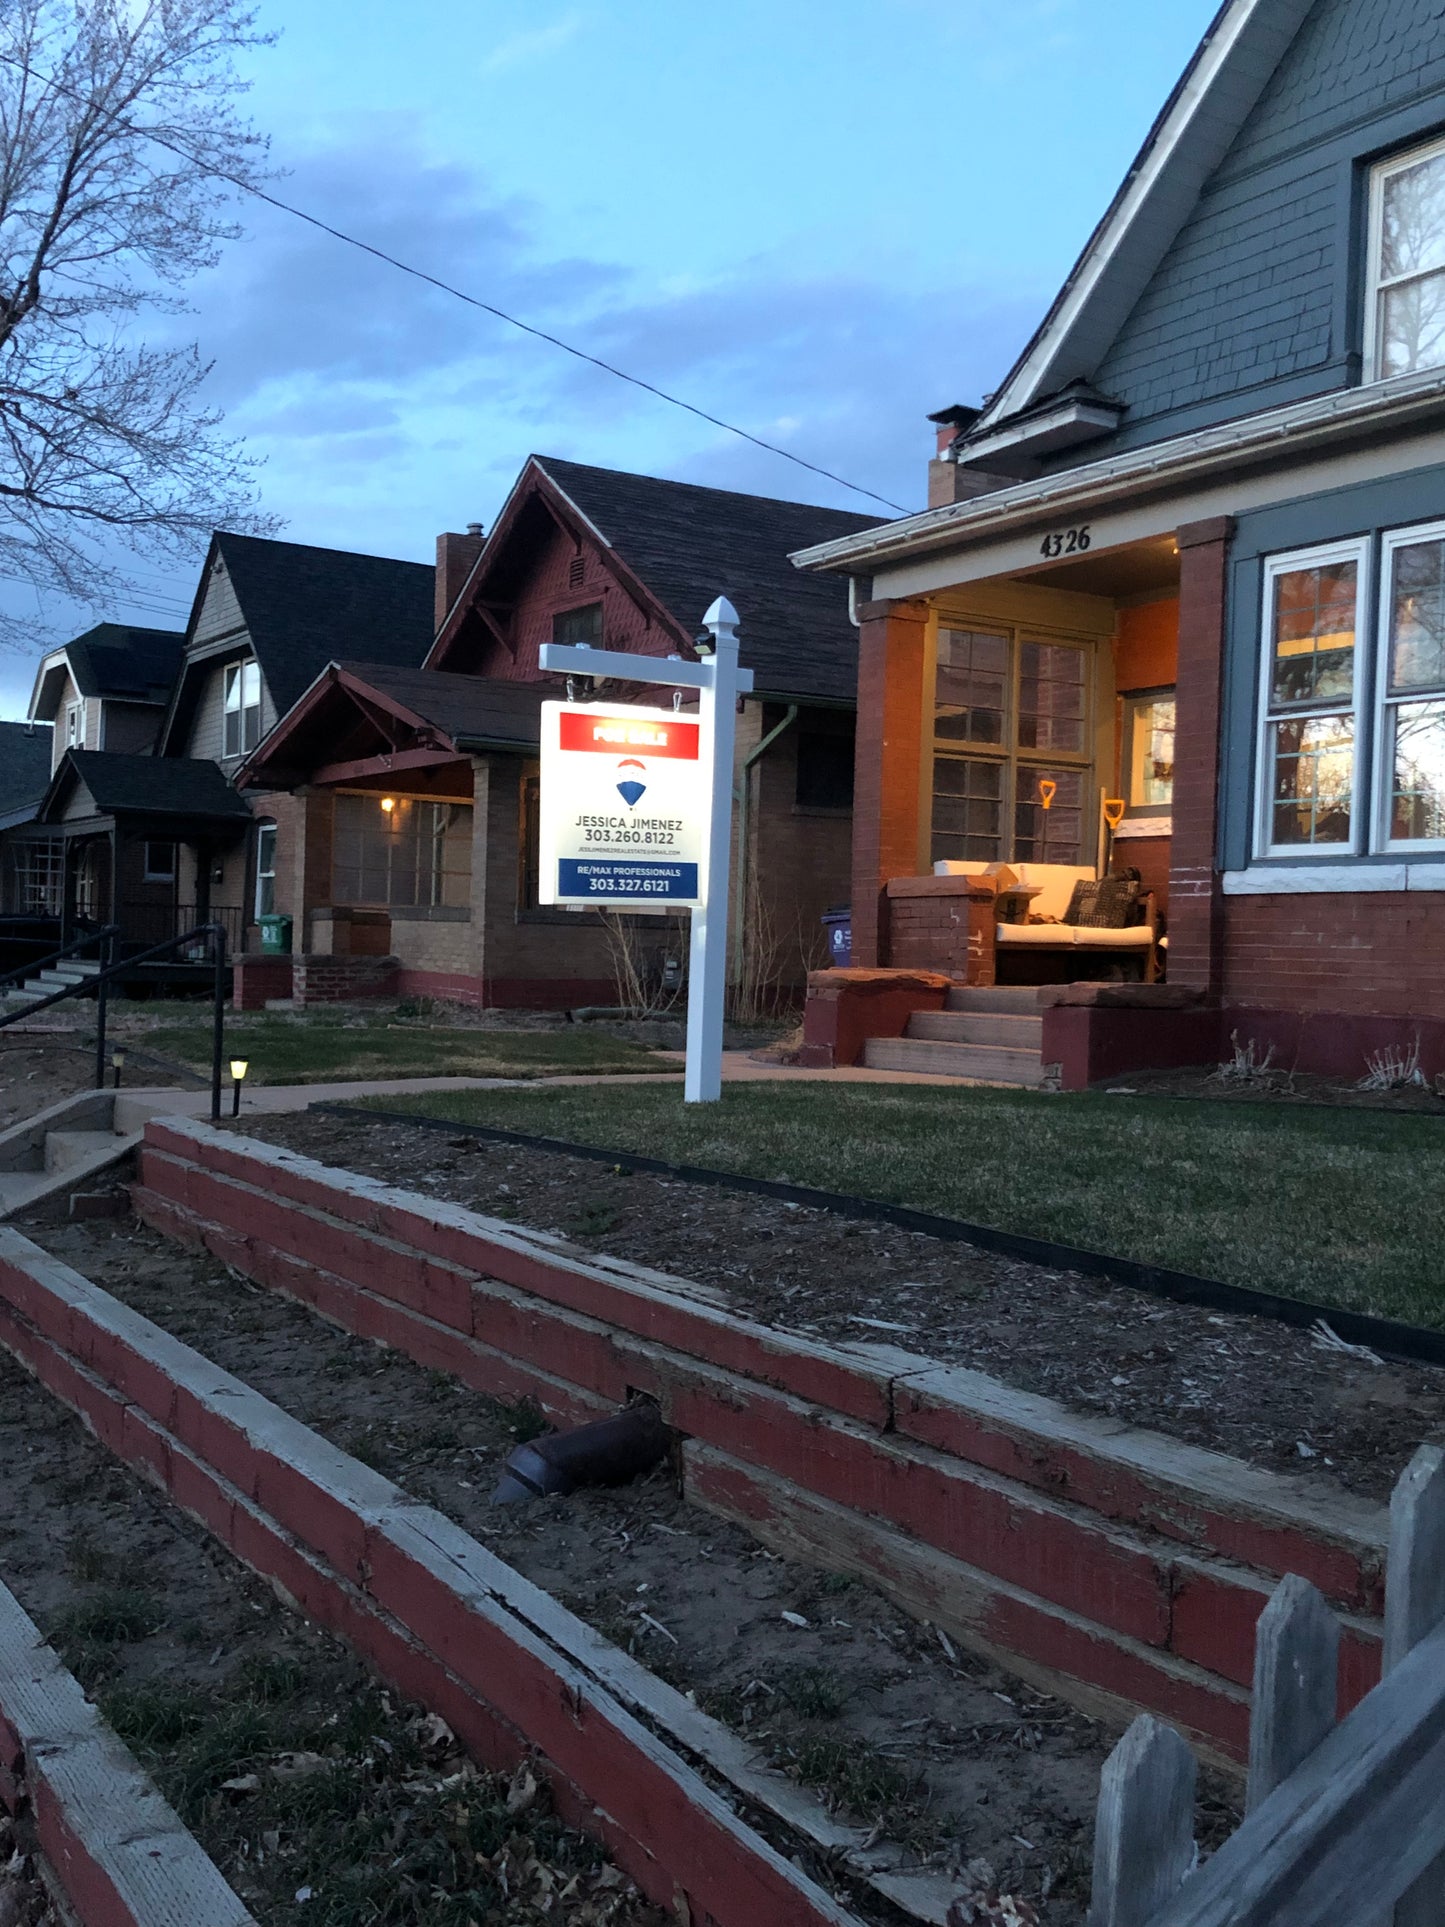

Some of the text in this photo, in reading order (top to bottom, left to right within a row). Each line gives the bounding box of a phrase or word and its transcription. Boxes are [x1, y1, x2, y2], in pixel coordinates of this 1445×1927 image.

[1040, 525, 1090, 558] 4326
[576, 816, 682, 831] JESSICA JIMENEZ
[585, 829, 674, 844] 303.260.8122
[577, 866, 681, 877] RE/MAX PROFESSIONALS
[589, 878, 669, 892] 303.327.6121
